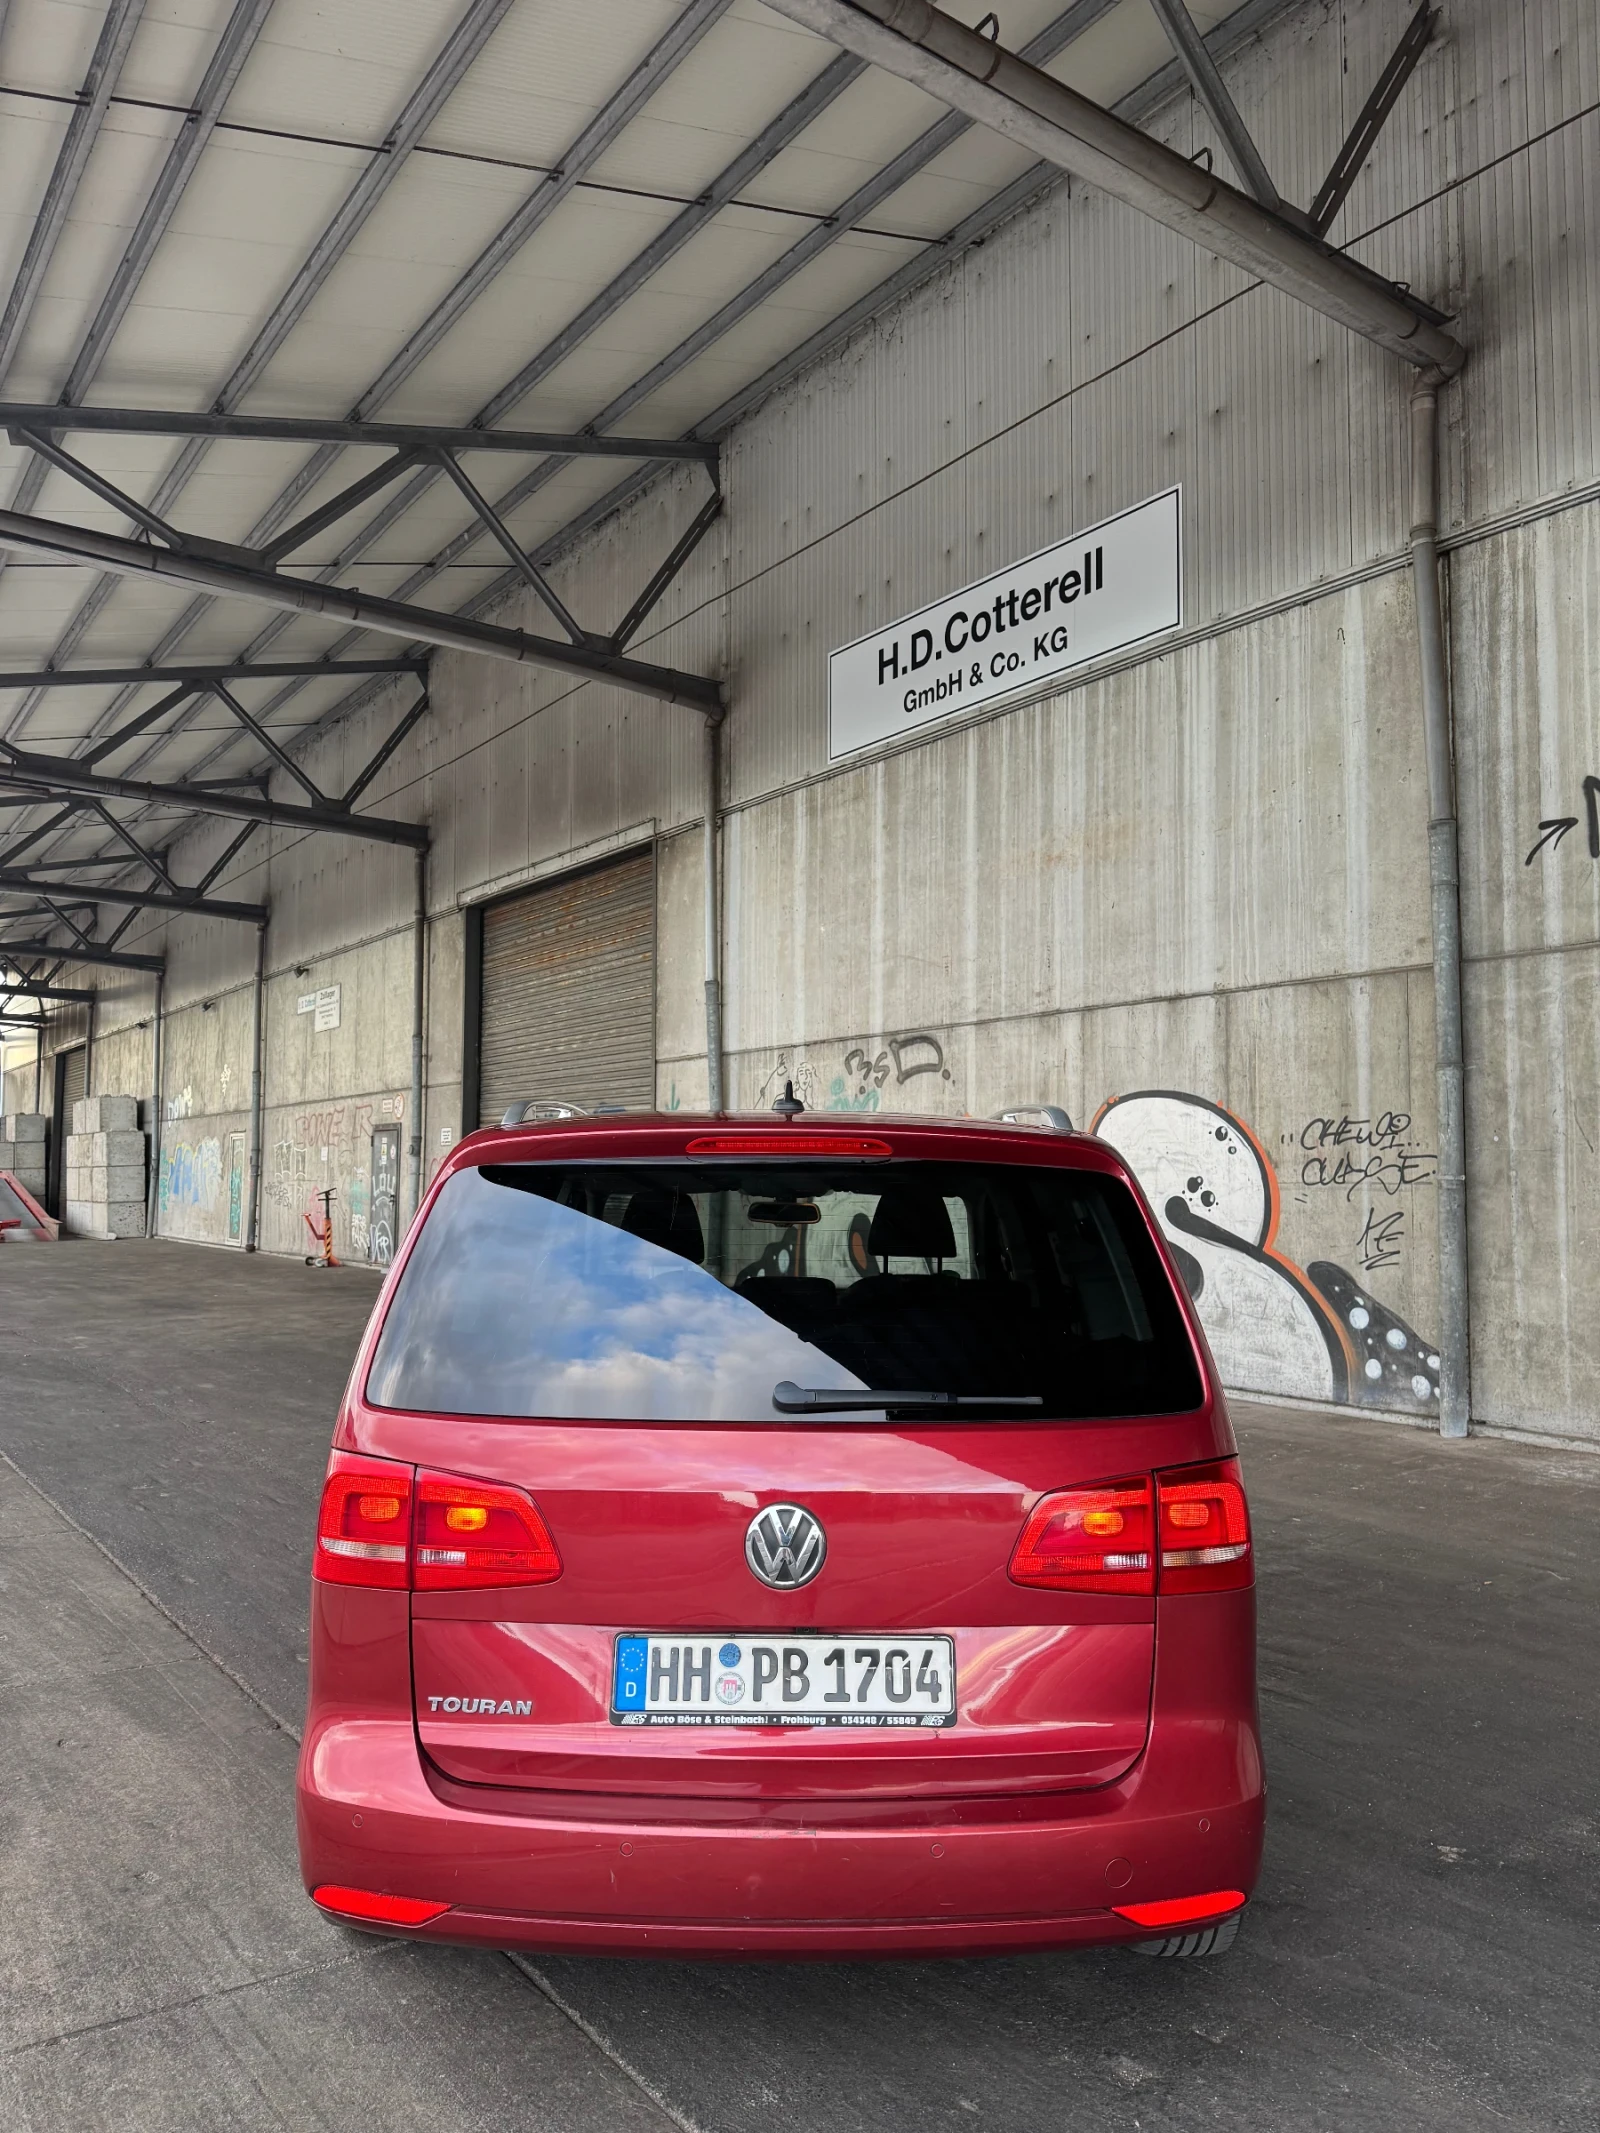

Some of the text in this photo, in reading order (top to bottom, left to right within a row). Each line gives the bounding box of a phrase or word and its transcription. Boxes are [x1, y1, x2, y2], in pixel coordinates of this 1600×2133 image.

[877, 546, 1104, 686] H.D.Cotterell
[903, 625, 1069, 714] GmbH & Co. KG
[625, 1682, 638, 1698] D
[649, 1646, 712, 1702] HH
[751, 1647, 811, 1703] PB
[823, 1647, 943, 1704] 1704
[427, 1696, 533, 1715] TOURAN
[650, 1715, 676, 1724] Auto
[677, 1715, 702, 1724] Böse
[704, 1715, 712, 1724] &
[780, 1715, 827, 1726] Frohburg
[878, 1716, 885, 1726] /
